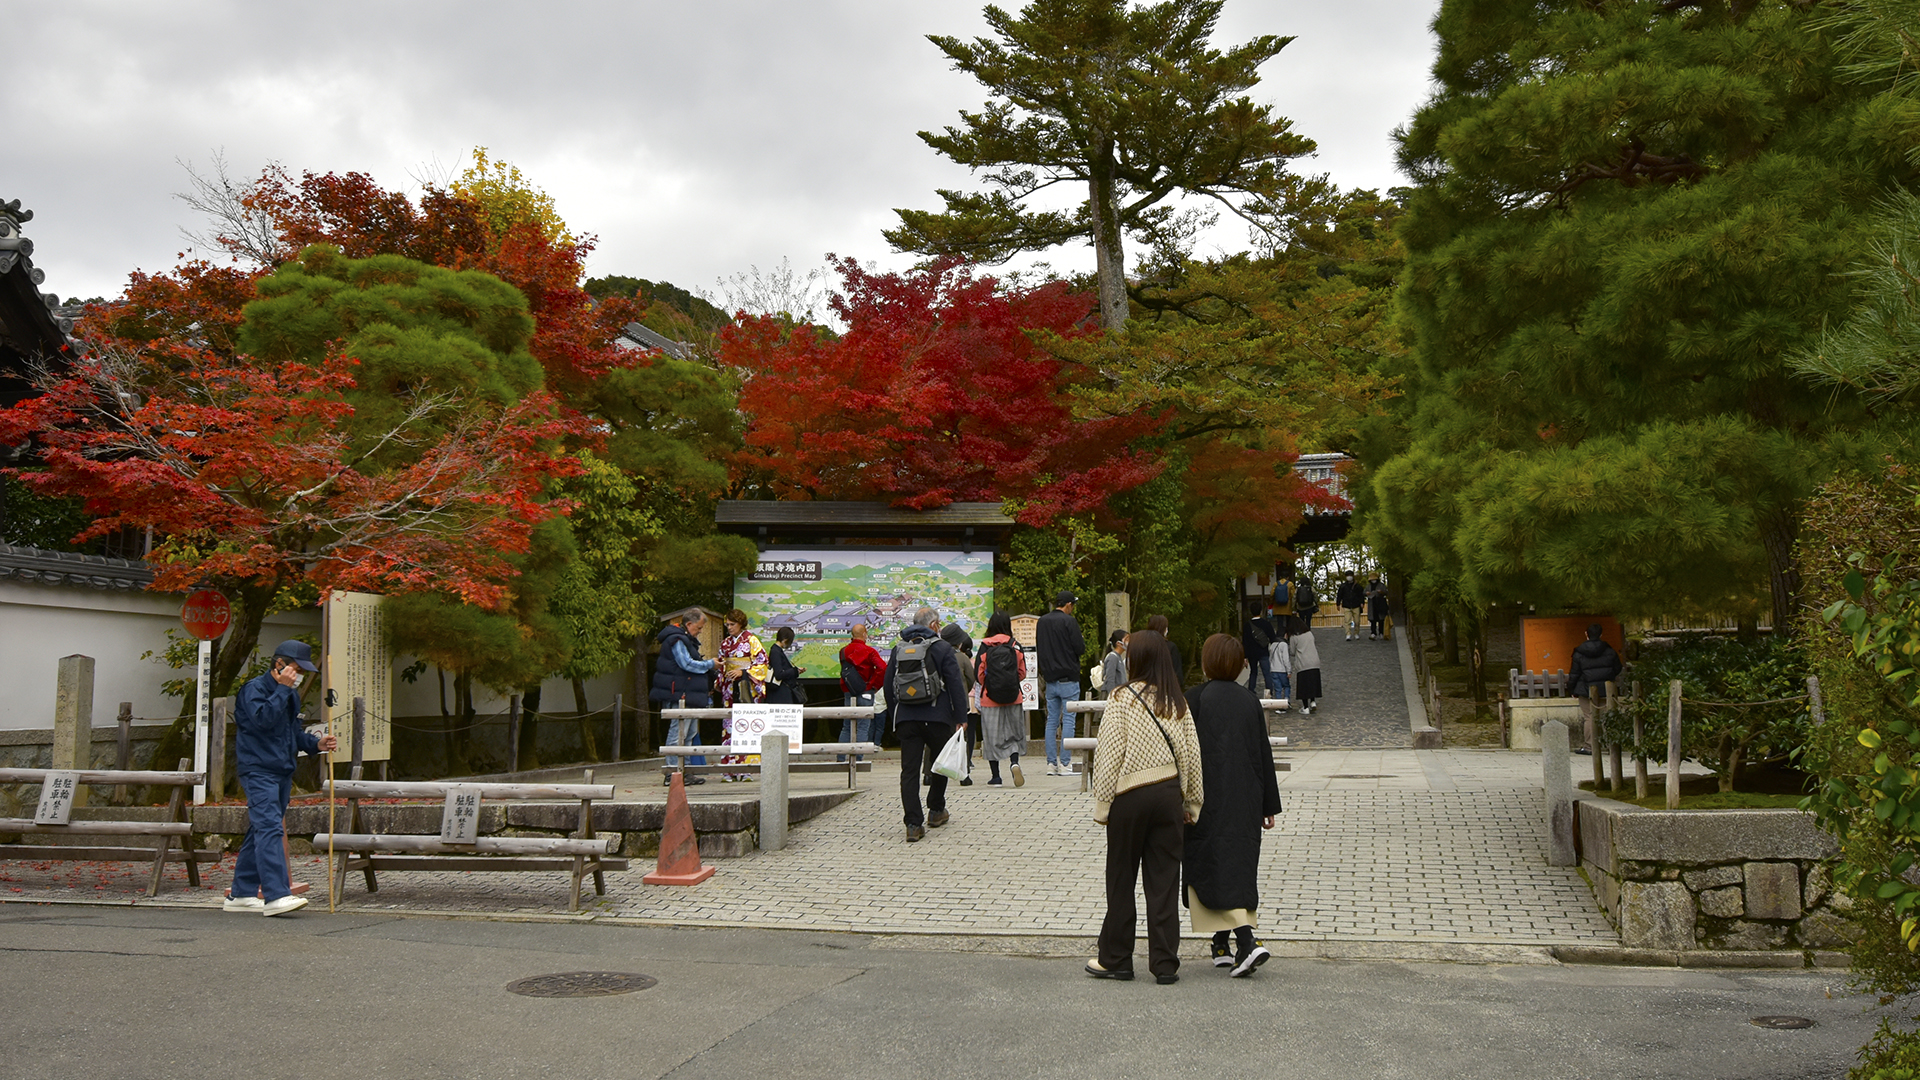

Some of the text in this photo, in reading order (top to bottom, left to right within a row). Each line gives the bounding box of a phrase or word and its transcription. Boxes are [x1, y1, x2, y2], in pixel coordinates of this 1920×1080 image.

[201, 656, 211, 723] 京都市消防局
[50, 777, 62, 819] 駐車禁止
[60, 778, 72, 800] 駐輪
[464, 794, 475, 817] 駐輪
[454, 794, 467, 839] 駐車禁止
